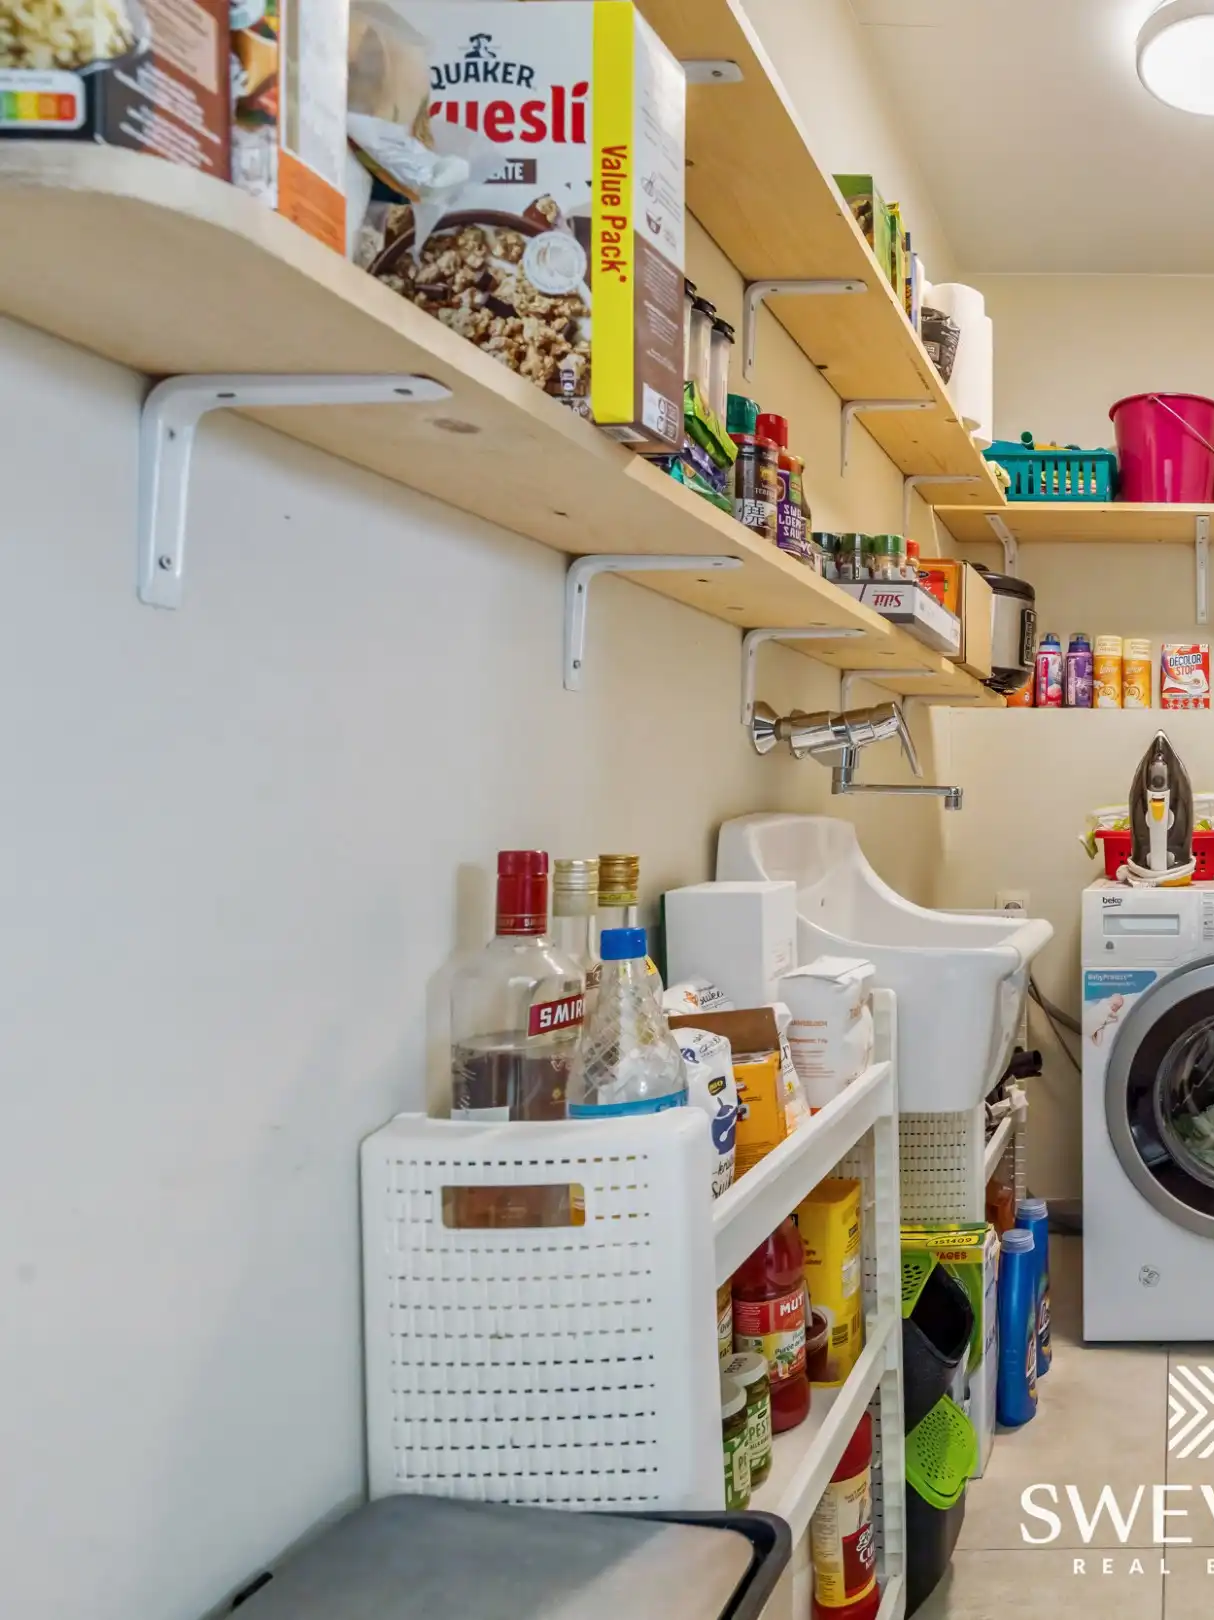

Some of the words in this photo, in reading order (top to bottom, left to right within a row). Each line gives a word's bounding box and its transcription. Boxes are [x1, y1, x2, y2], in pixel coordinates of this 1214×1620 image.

[430, 61, 535, 90] QUAKER
[601, 145, 628, 206] Value
[1176, 665, 1195, 676] STOP
[1102, 896, 1122, 905] beko
